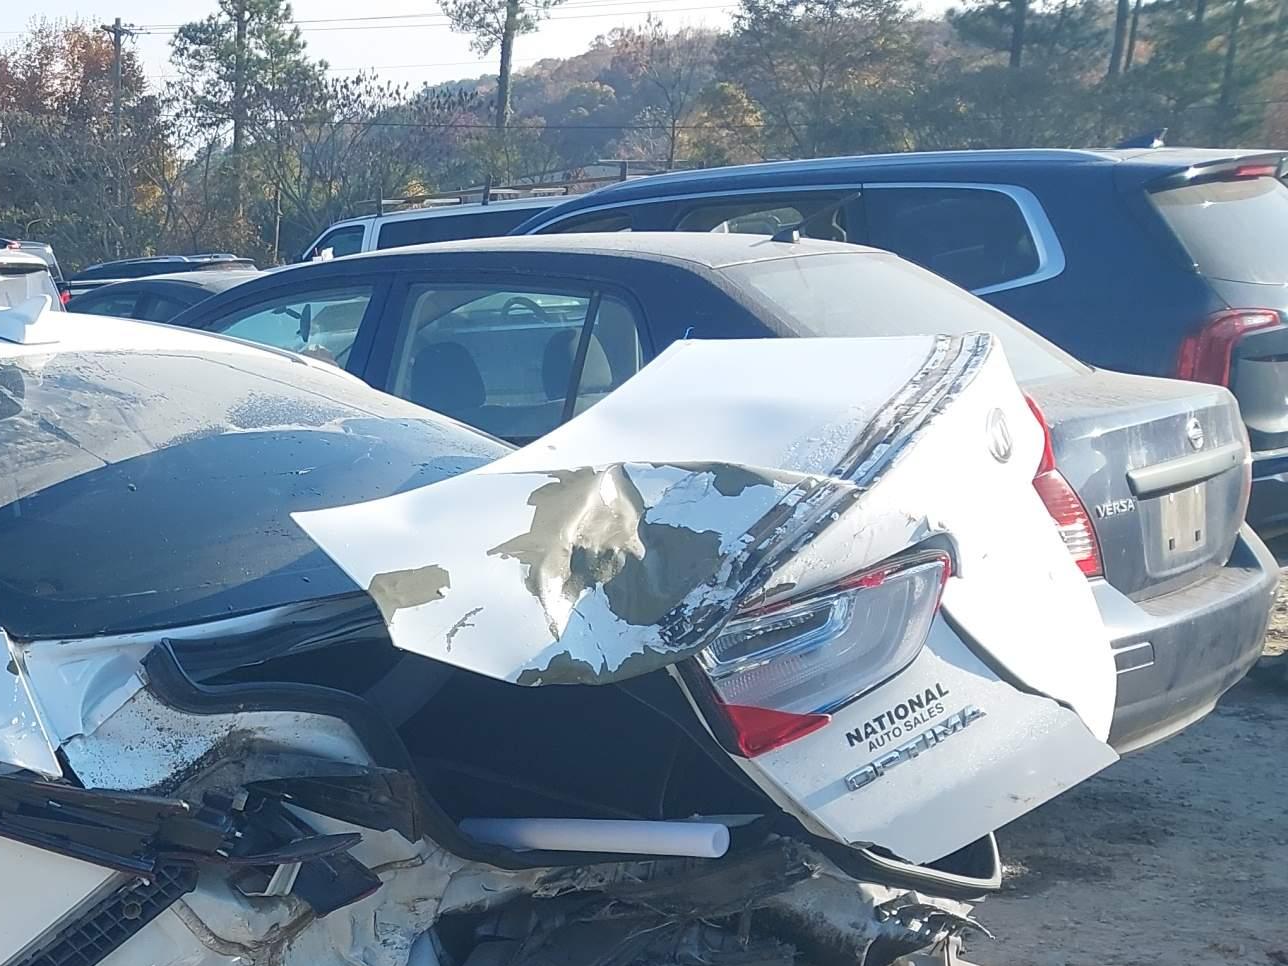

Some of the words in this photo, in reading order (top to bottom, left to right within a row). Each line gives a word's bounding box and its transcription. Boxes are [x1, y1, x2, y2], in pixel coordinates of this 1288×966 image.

[1095, 499, 1136, 518] VERSA
[845, 682, 949, 747] NATIONAL
[867, 726, 903, 752] AUTO
[903, 702, 945, 732] SALES
[844, 703, 987, 792] OPTIMA
